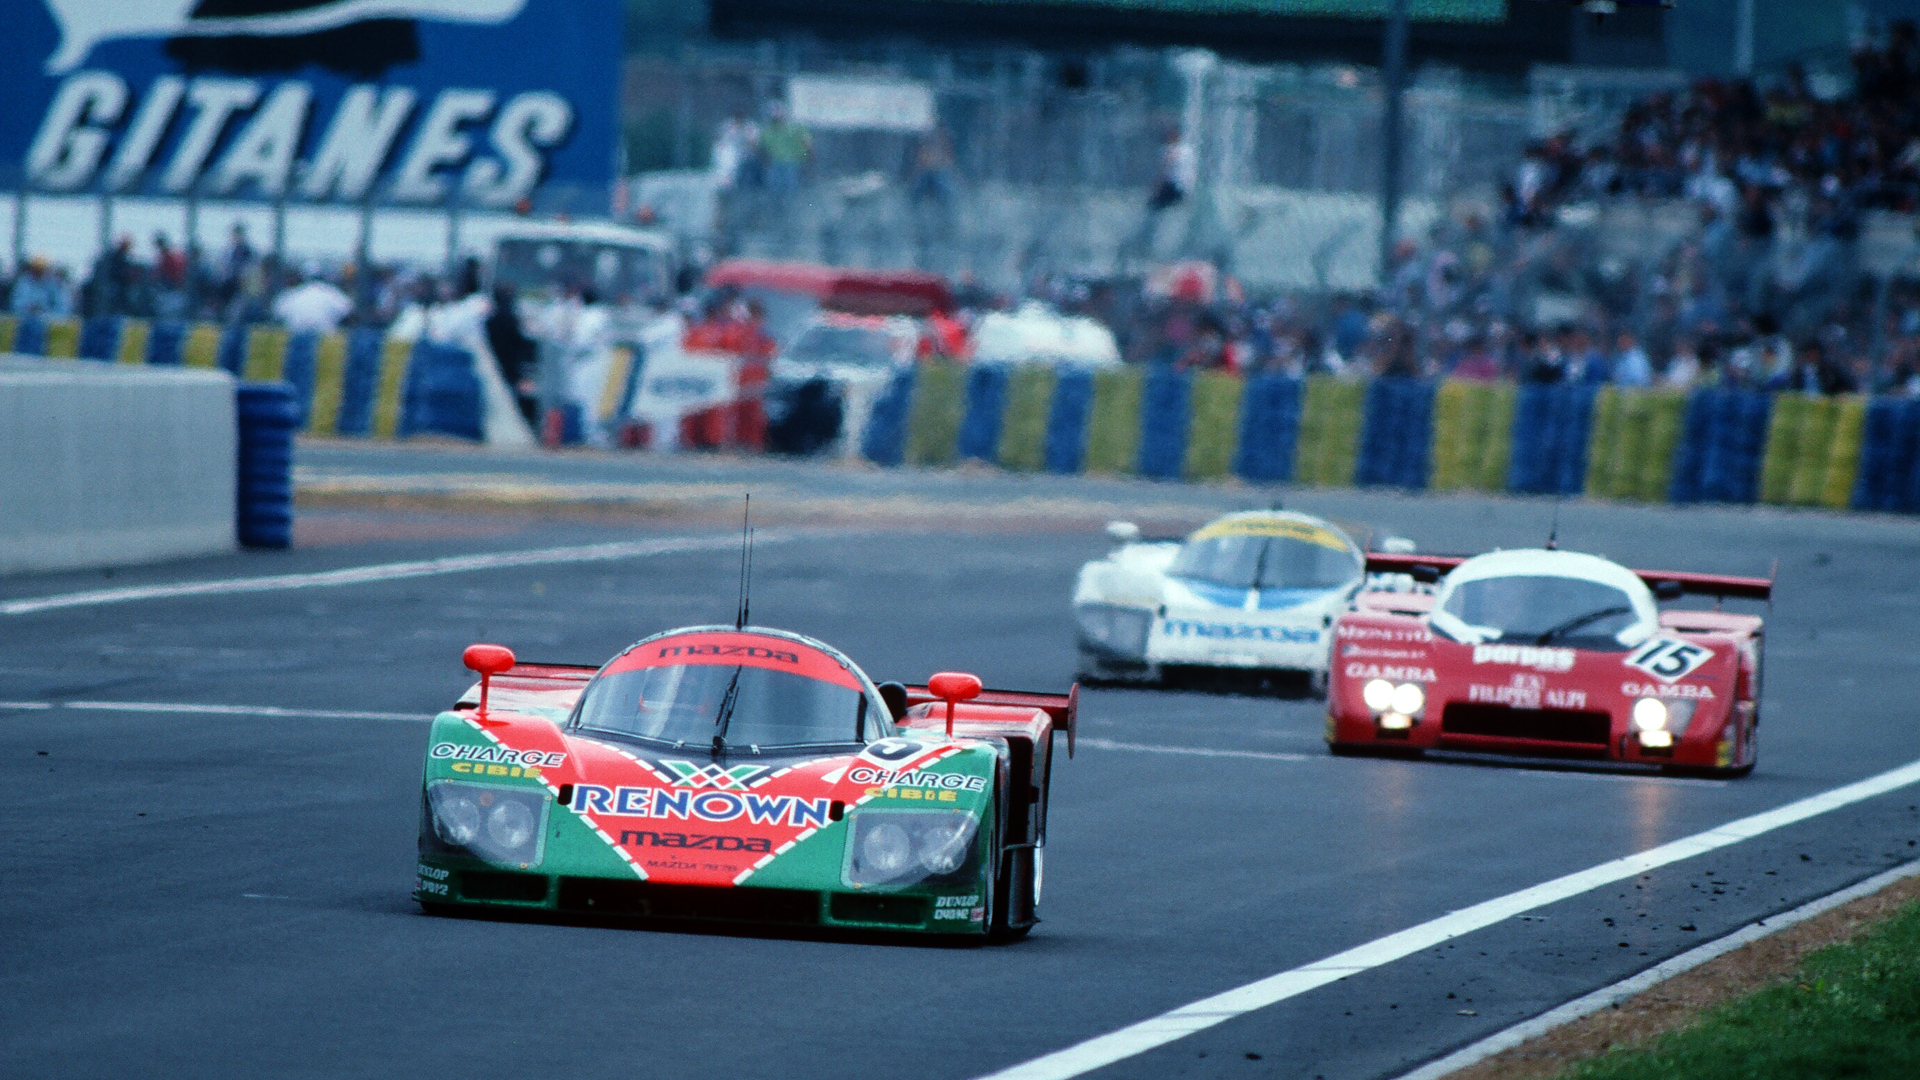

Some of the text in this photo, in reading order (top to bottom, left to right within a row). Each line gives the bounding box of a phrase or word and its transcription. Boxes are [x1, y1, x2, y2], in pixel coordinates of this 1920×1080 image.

[24, 70, 574, 204] GITANES
[1635, 640, 1703, 677] 15
[1345, 662, 1437, 682] GAMBA
[1621, 681, 1716, 698] GAMBA
[430, 742, 568, 768] CHARGE
[849, 767, 987, 792] CHARGE
[570, 783, 831, 828] RENOWN
[647, 860, 697, 870] MAZDA
